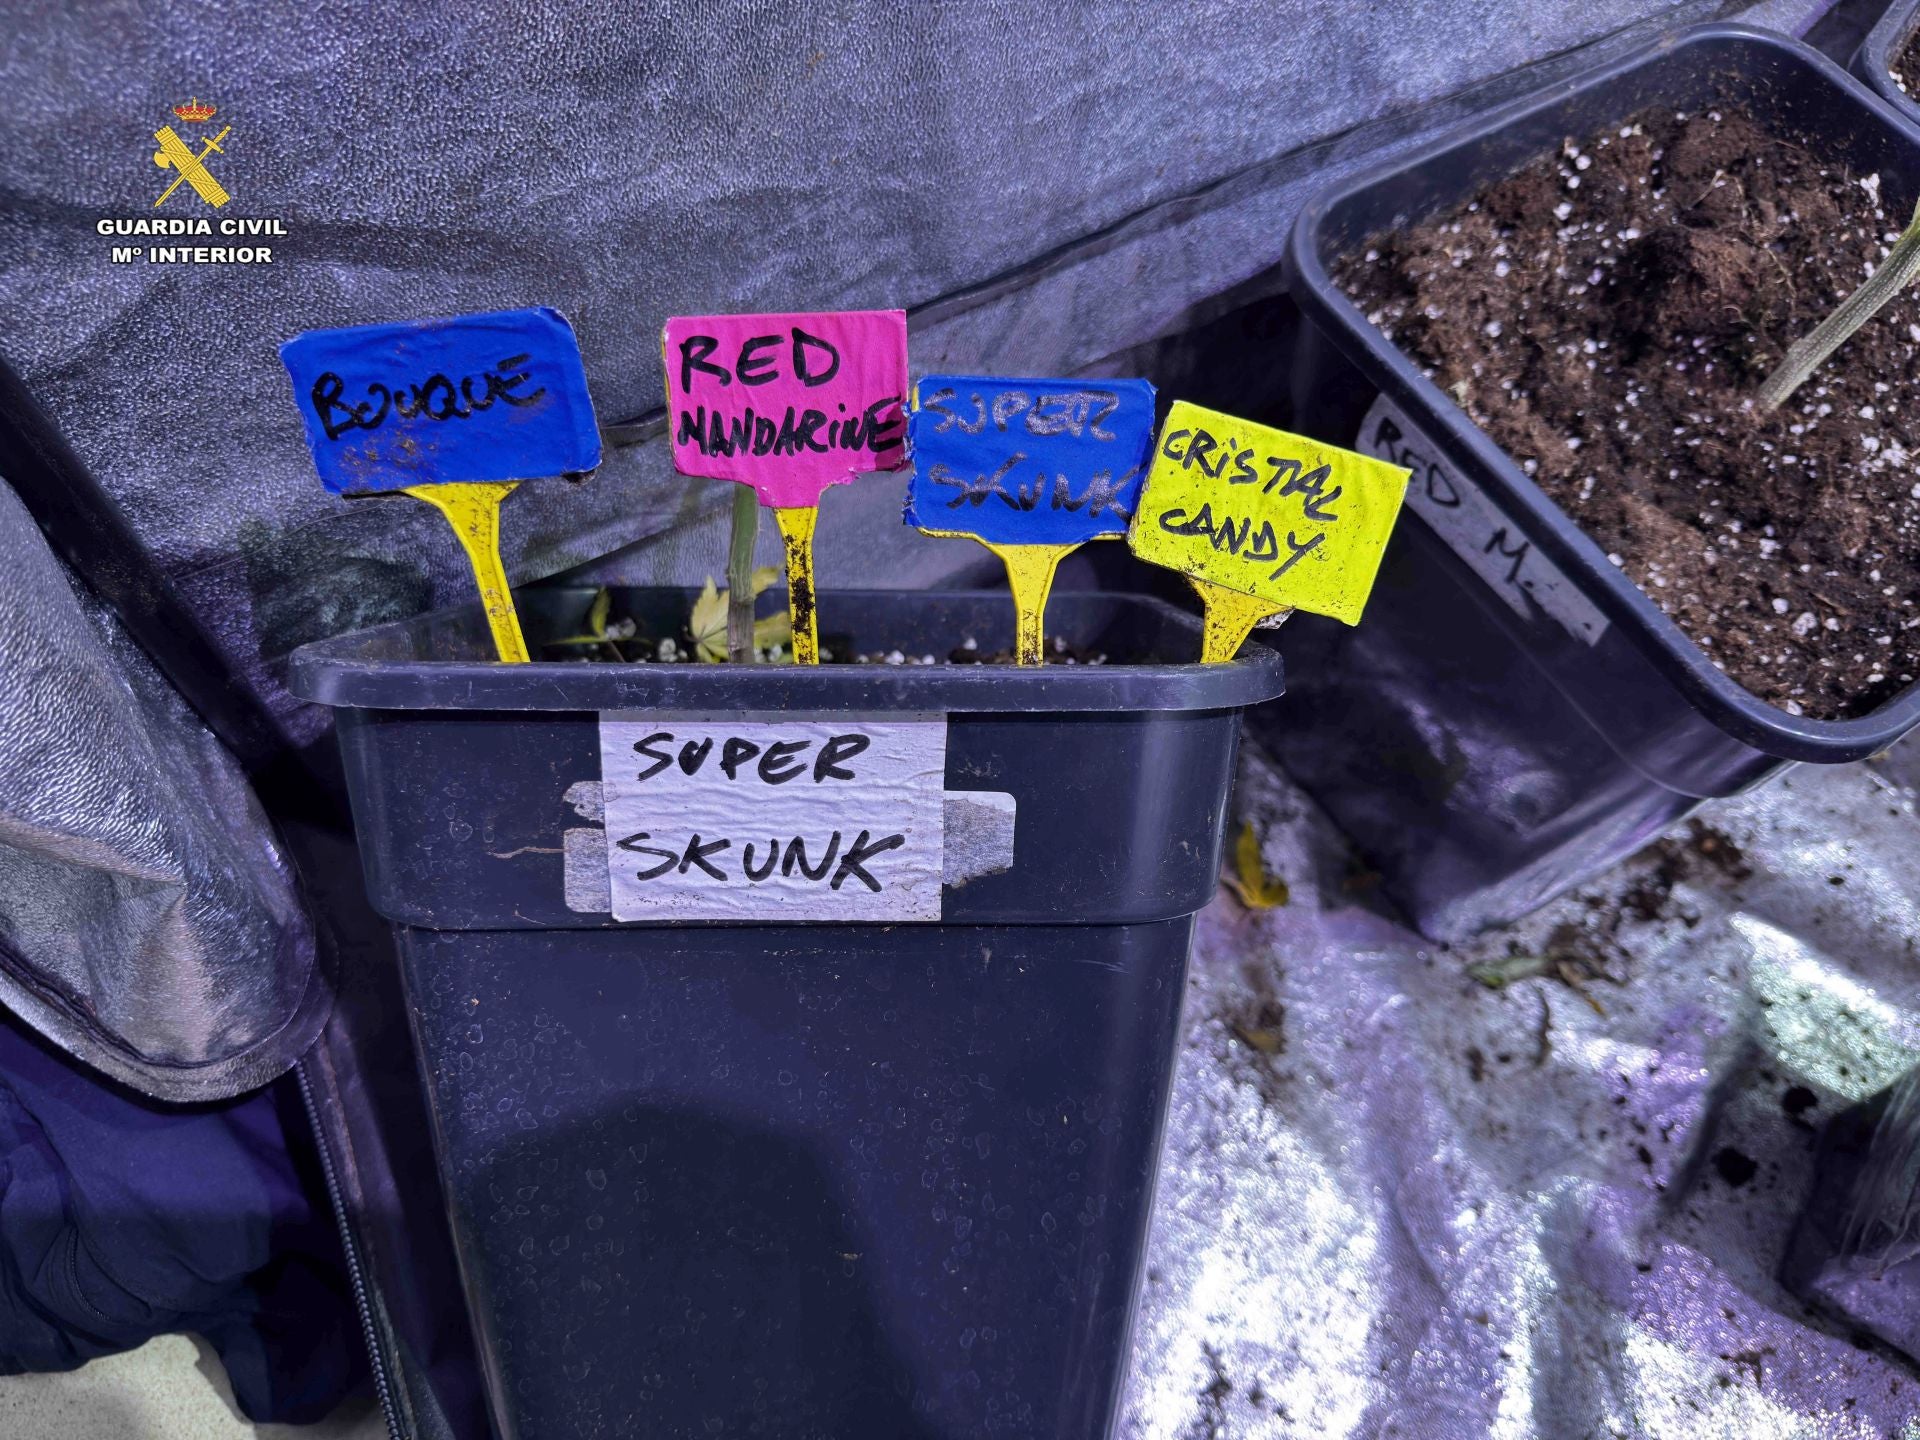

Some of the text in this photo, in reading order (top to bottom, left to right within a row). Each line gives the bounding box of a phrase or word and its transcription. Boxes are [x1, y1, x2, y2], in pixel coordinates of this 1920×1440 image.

[679, 327, 840, 394] RED
[928, 452, 1148, 525] SKUNK
[1374, 417, 1460, 508] RED
[1158, 502, 1326, 582] CANDY
[632, 732, 871, 786] SUPER
[616, 830, 906, 893] SKUNK
